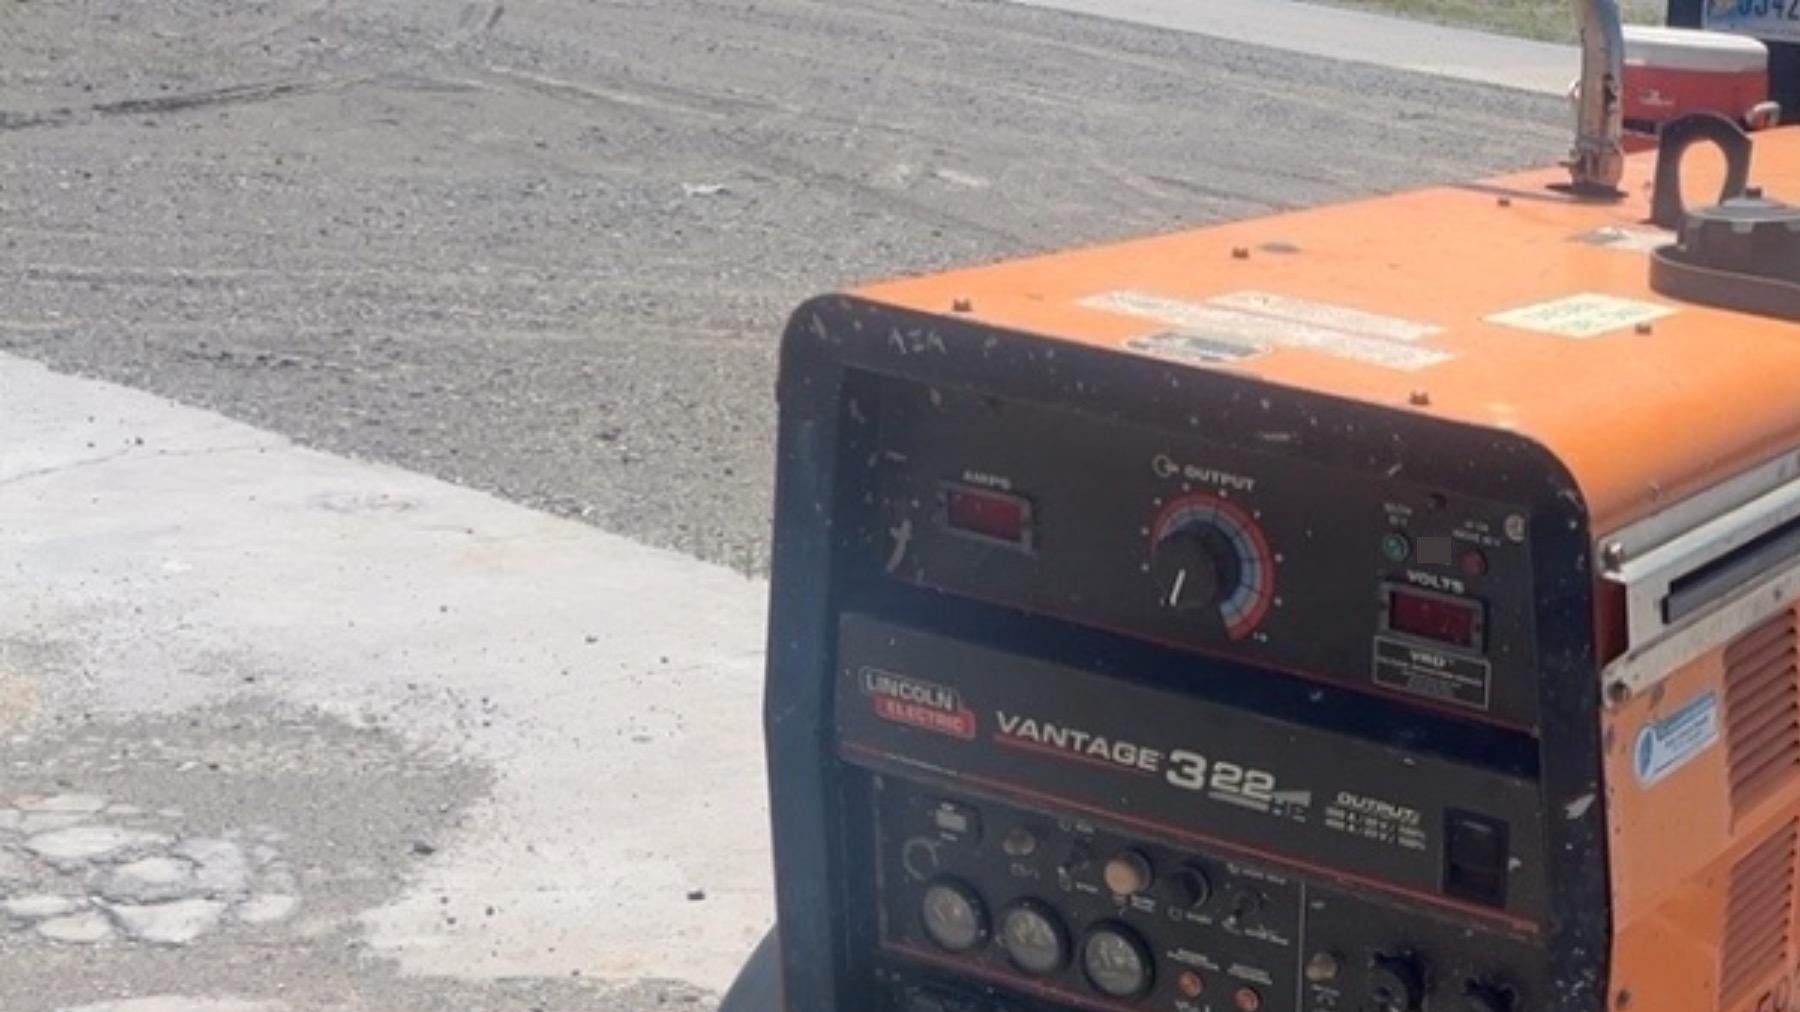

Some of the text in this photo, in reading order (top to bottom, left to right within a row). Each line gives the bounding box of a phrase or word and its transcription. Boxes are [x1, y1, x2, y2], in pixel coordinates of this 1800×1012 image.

[1183, 463, 1255, 491] OUTPUT
[1405, 569, 1466, 594] VOLTS
[864, 671, 953, 711] LINCOLN
[995, 710, 1275, 802] VANTAGE 322
